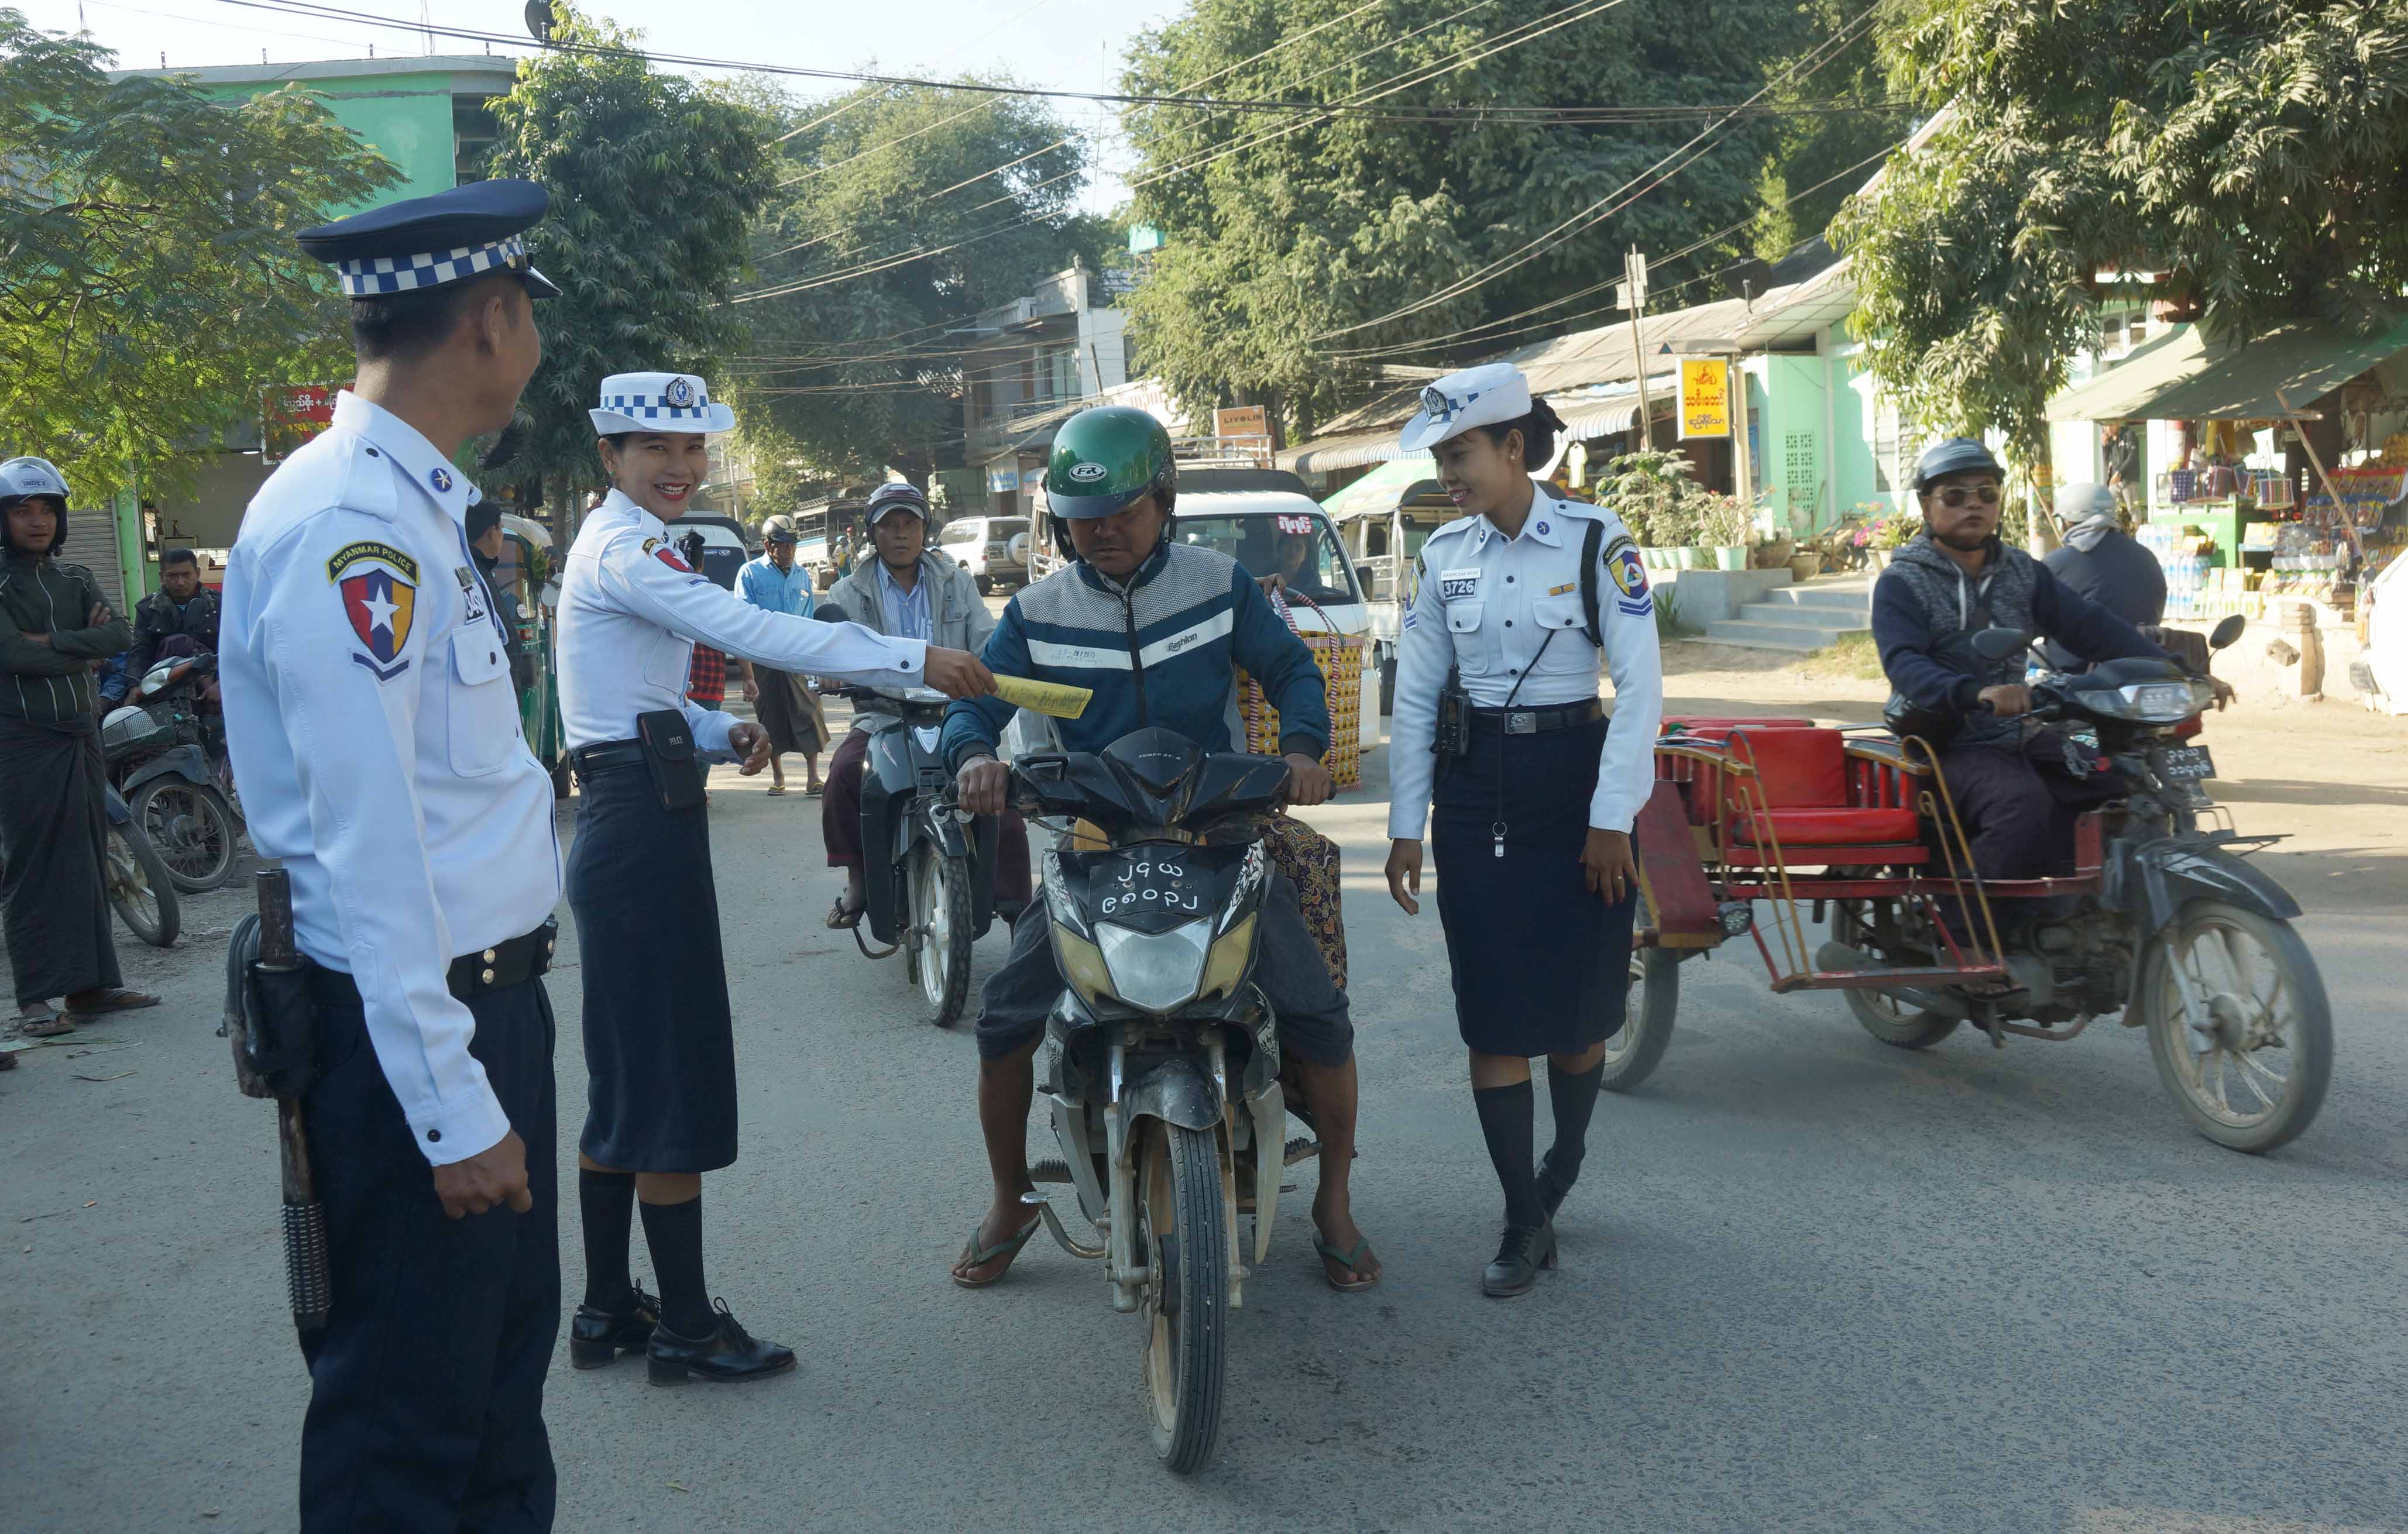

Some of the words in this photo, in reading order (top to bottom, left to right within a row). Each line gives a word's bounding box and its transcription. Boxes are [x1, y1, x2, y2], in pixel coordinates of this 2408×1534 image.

[333, 545, 380, 569] MYANMAR
[382, 548, 412, 571] POLICE
[1445, 580, 1474, 595] 3726
[1167, 633, 1198, 652] Fashion
[1058, 648, 1095, 658] LI-NING
